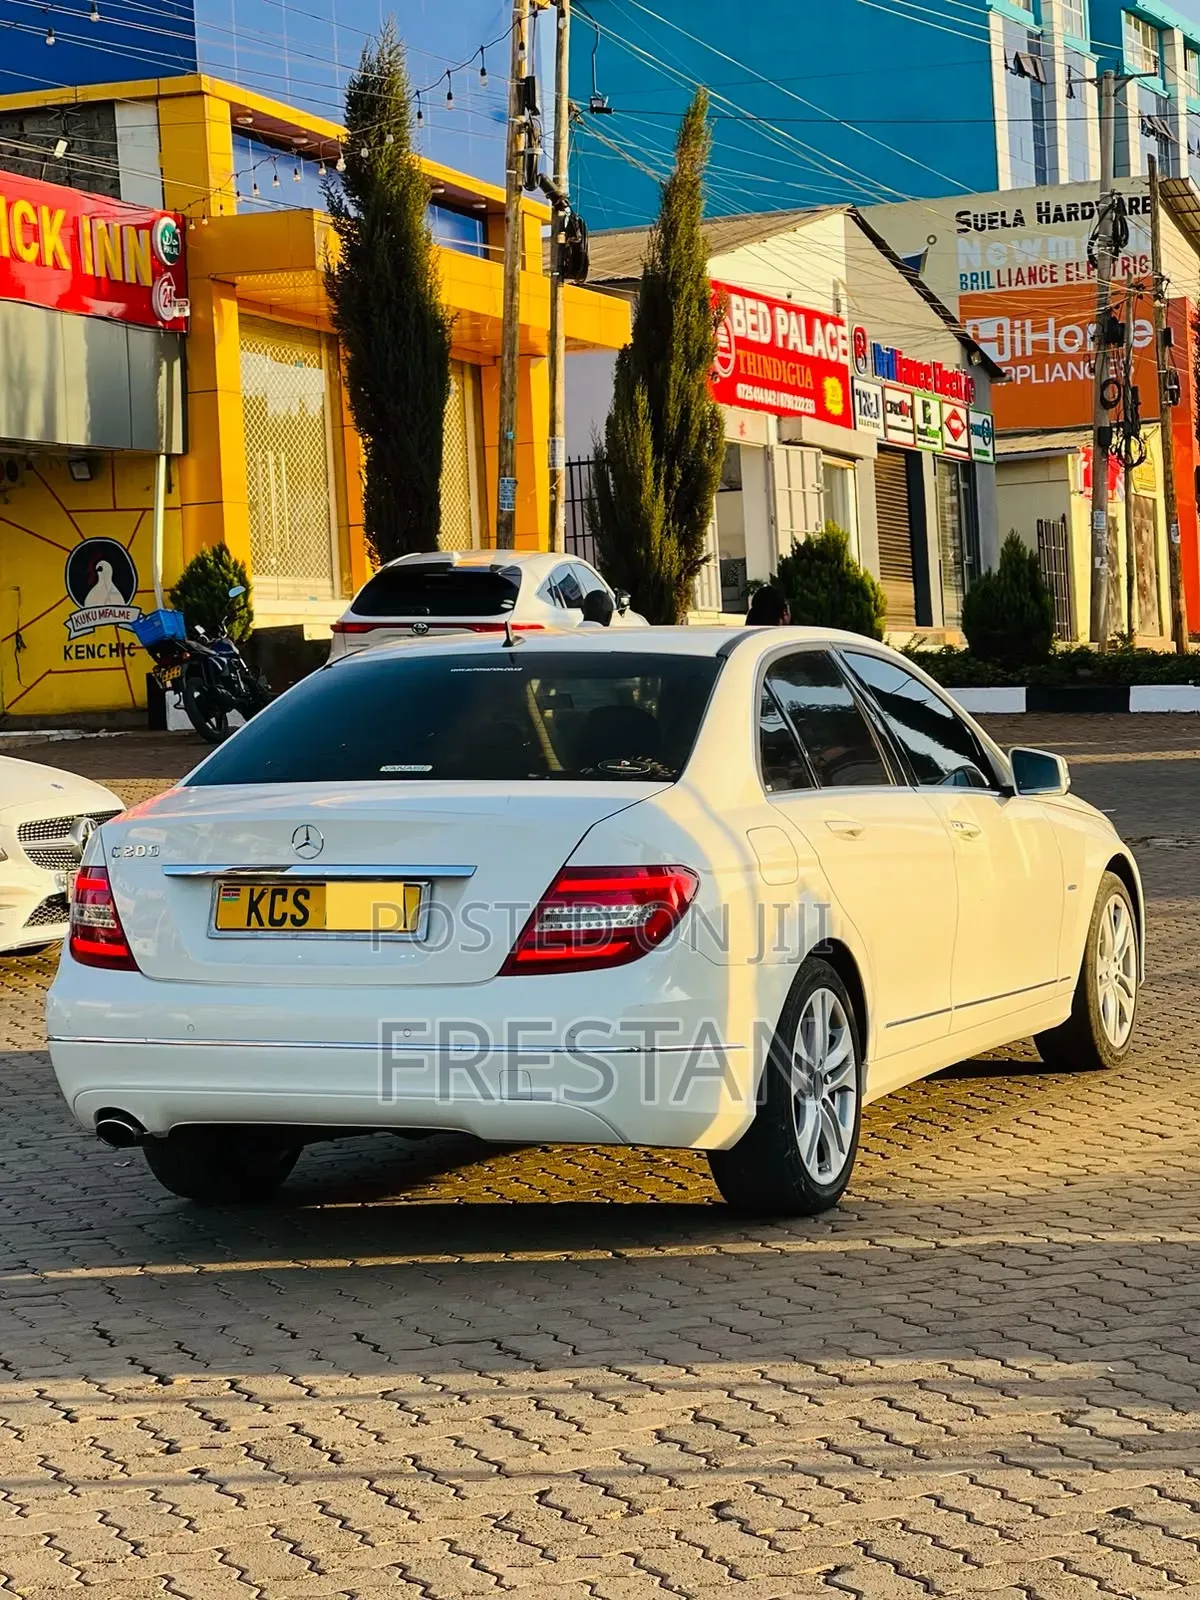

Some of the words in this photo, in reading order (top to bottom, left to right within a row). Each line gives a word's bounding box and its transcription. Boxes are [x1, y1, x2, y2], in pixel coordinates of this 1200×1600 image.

[955, 209, 1026, 235] SUELA
[1036, 196, 1151, 226] HARDARE
[79, 213, 153, 288] INN
[958, 264, 1059, 292] BRILLIANCE
[731, 293, 772, 345] BED
[774, 306, 850, 366] PALACE
[736, 348, 815, 390] THINDIGUA
[73, 611, 97, 628] KUKU
[63, 642, 137, 661] KENCHIC
[246, 886, 310, 929] KCS
